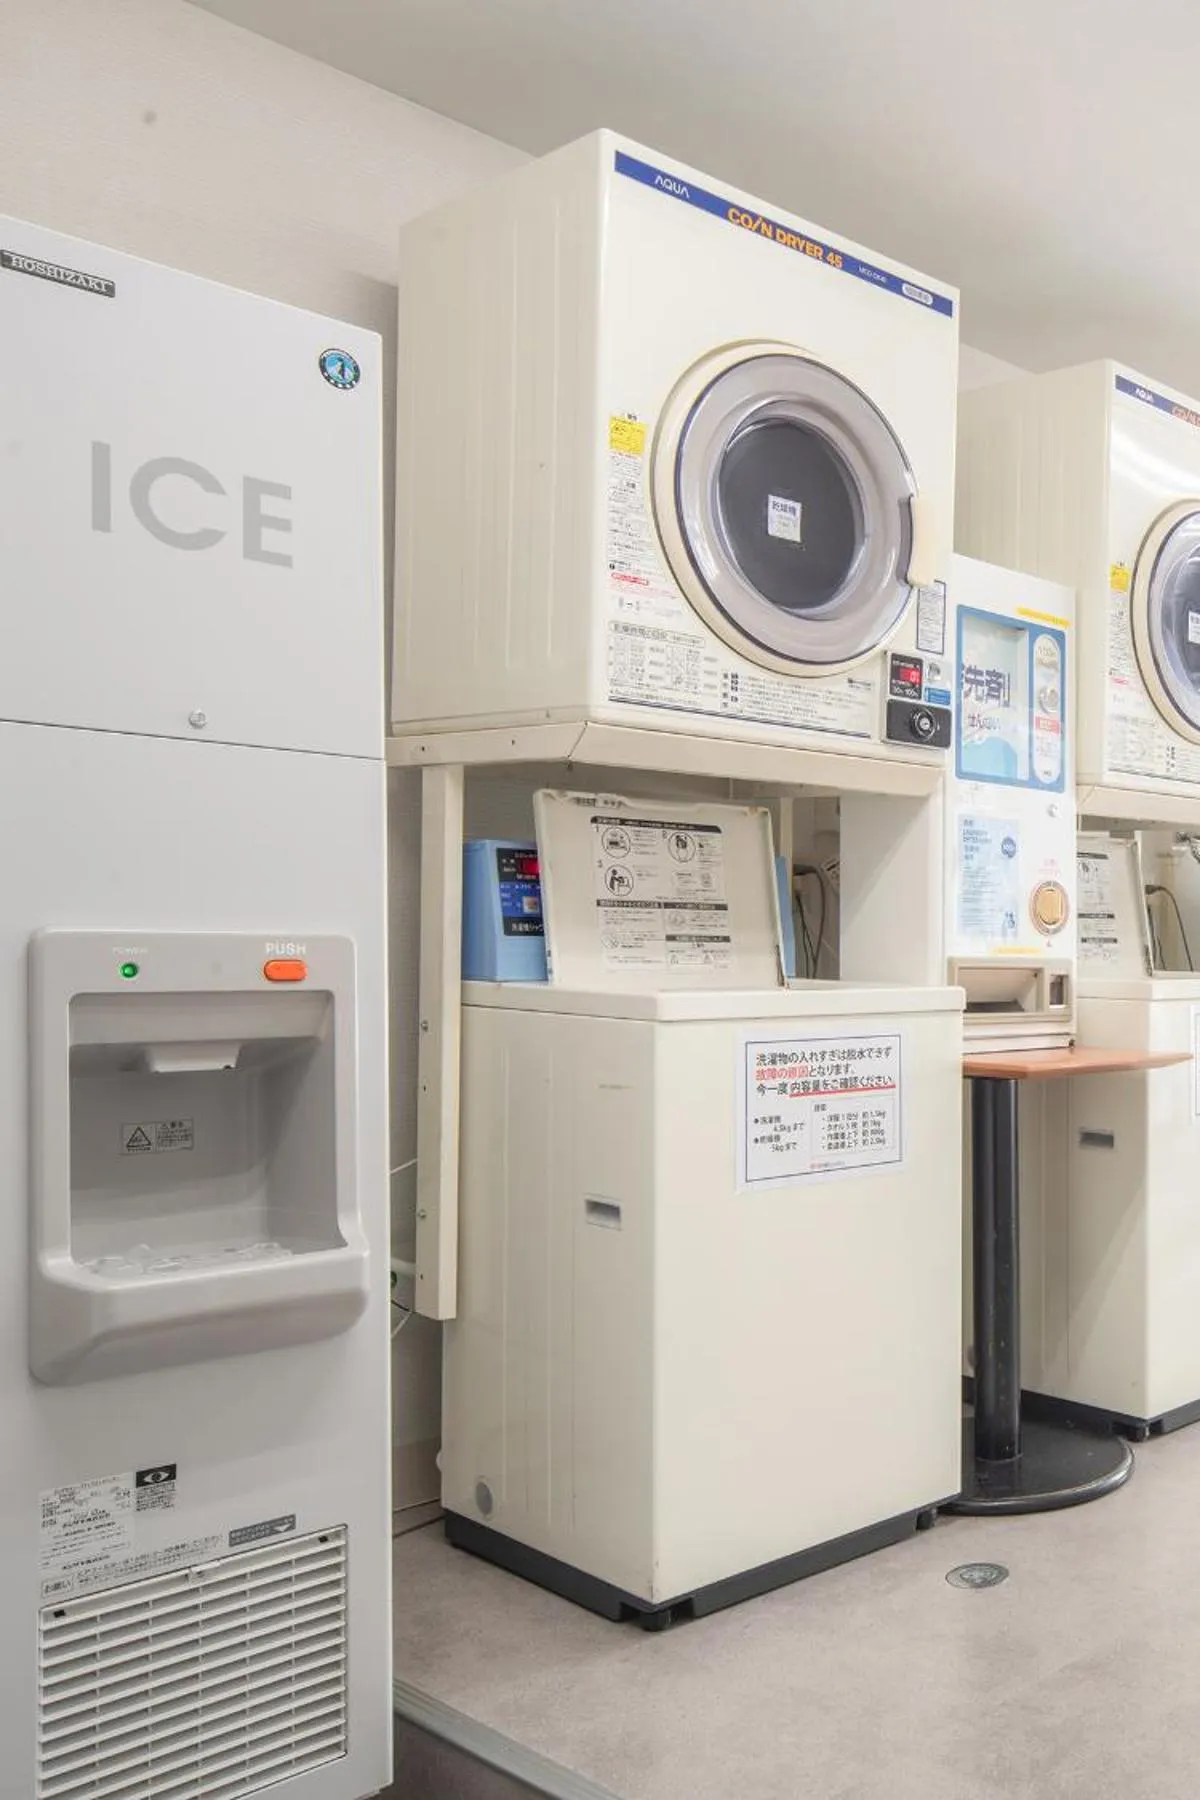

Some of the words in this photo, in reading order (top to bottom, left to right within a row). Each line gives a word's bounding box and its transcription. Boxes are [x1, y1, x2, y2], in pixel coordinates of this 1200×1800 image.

[654, 175, 690, 199] AQUA
[776, 229, 824, 260] DRYER
[9, 254, 113, 292] HOSHIZAKI
[91, 440, 293, 568] ICE
[265, 941, 307, 955] PUSH
